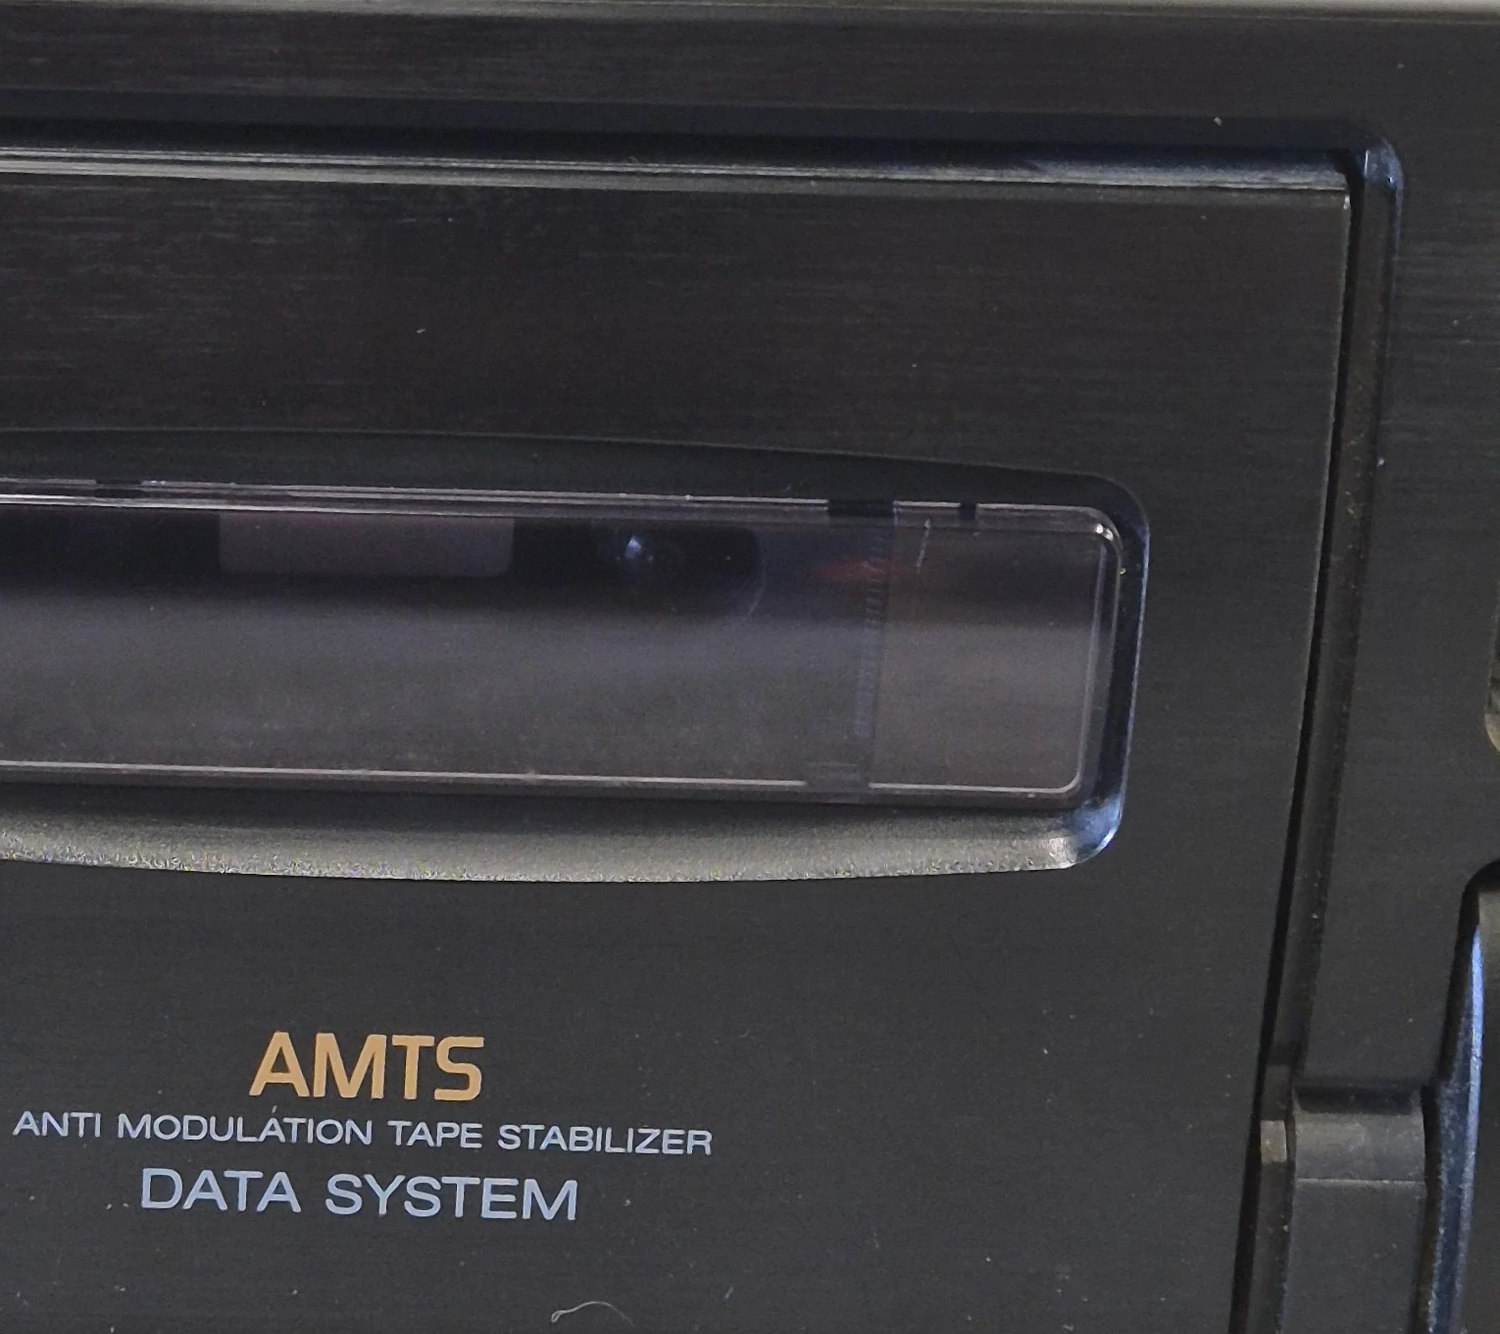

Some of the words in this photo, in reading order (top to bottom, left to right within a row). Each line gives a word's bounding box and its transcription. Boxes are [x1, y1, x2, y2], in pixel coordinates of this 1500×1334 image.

[248, 1031, 485, 1101] AMTS
[12, 1110, 101, 1139] ANTI
[116, 1112, 373, 1146] MODULATION
[387, 1120, 483, 1149] TAPE
[499, 1123, 713, 1155] STABILIZER
[140, 1168, 302, 1214] DATA
[325, 1174, 579, 1221] SYSTEM
